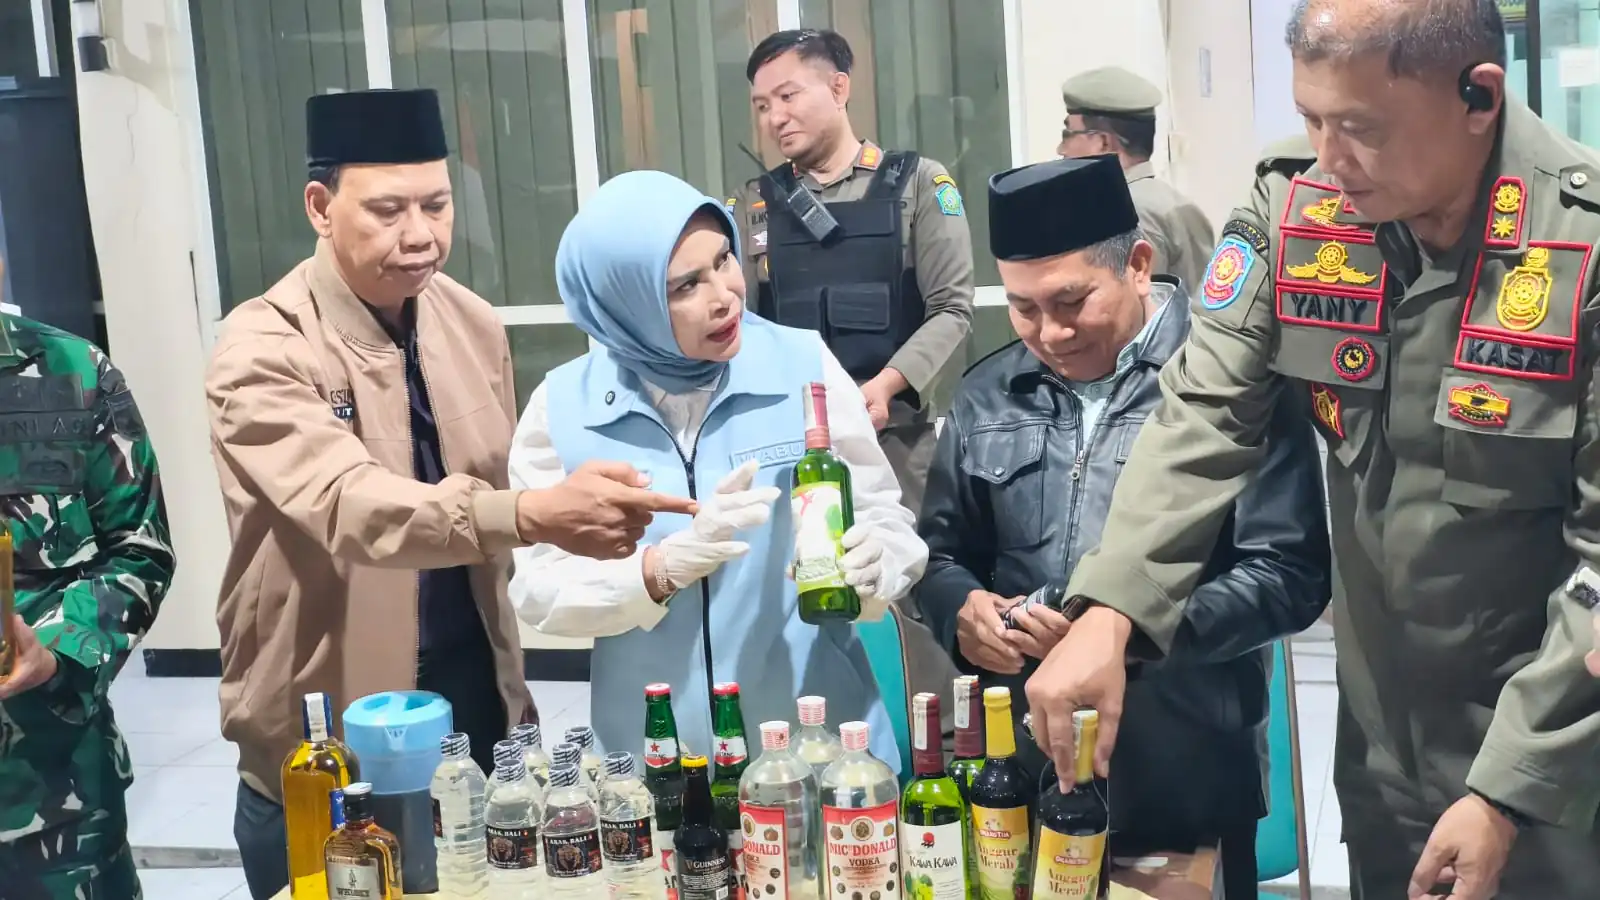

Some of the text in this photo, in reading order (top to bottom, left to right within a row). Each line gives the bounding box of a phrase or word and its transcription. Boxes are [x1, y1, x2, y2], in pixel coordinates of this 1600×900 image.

[1290, 292, 1368, 323] YANY
[1465, 338, 1563, 373] KASAT
[693, 856, 726, 868] GUINNESS
[849, 857, 881, 867] VODKA
[910, 855, 958, 868] KAWA KAWA
